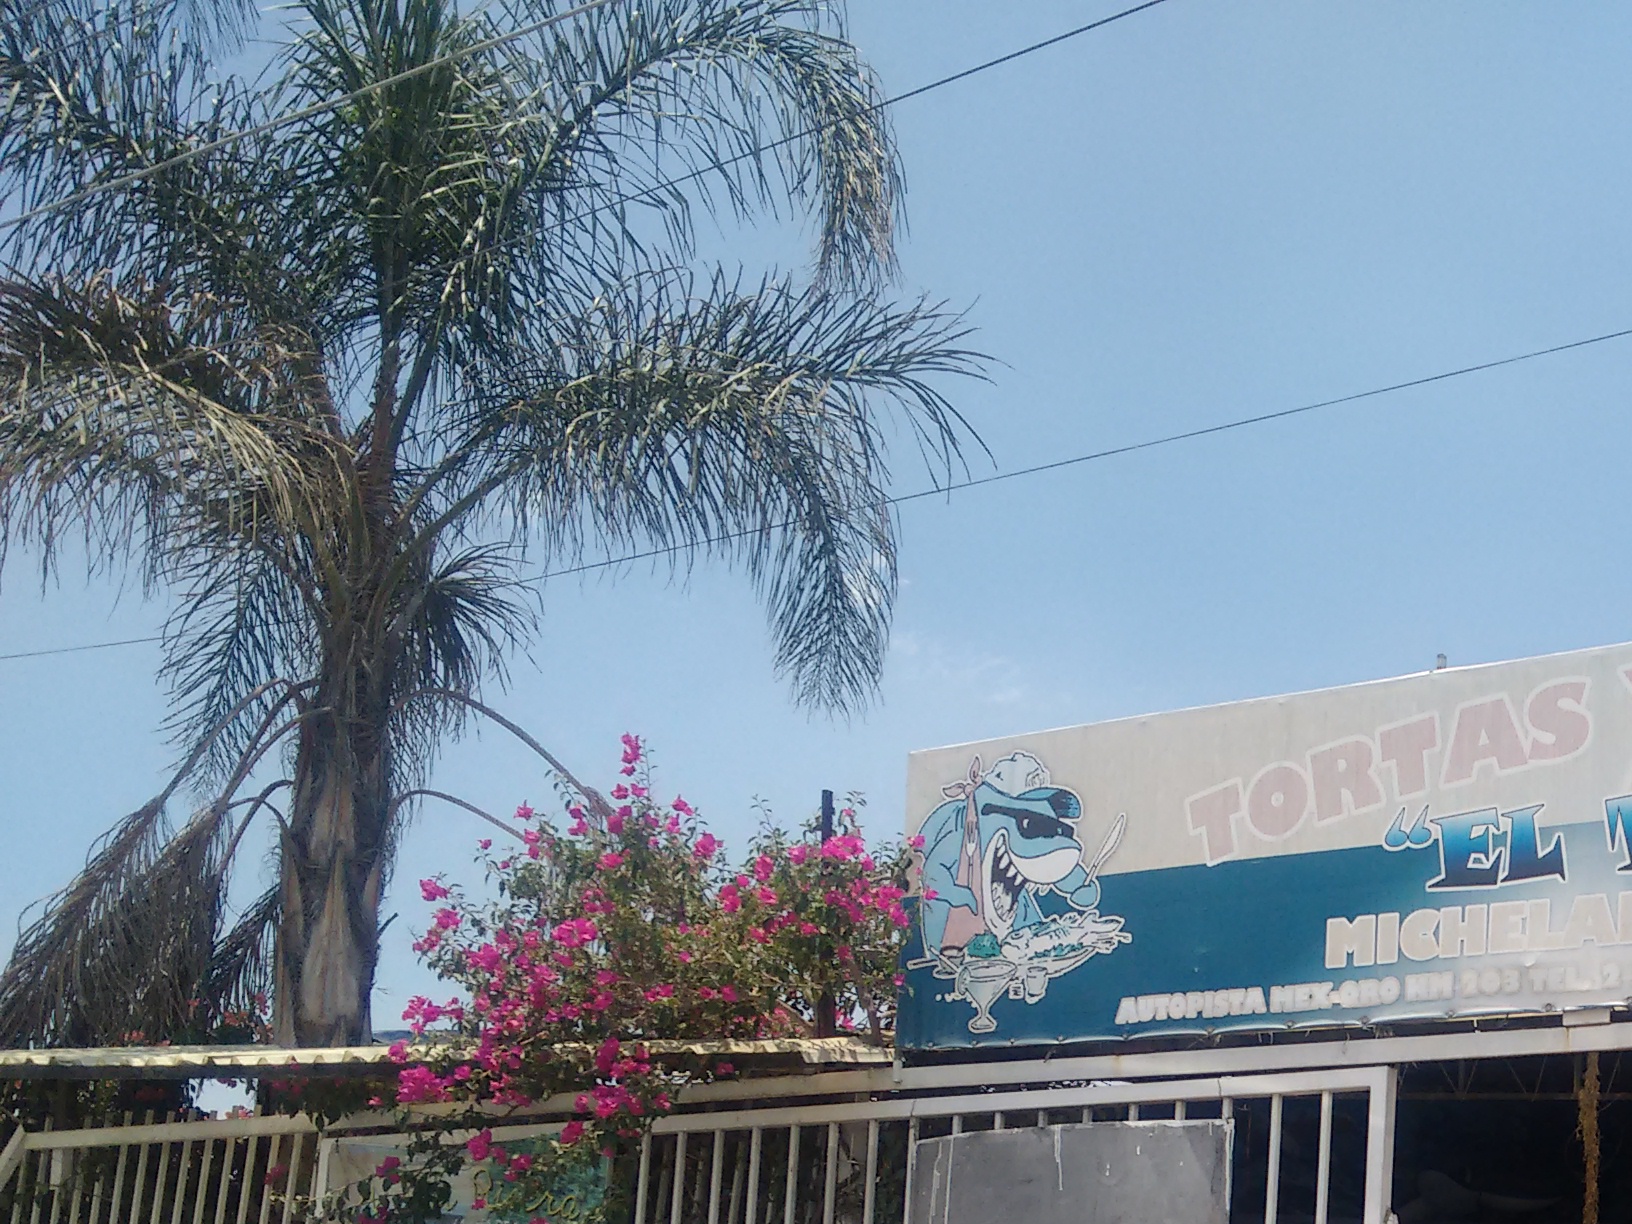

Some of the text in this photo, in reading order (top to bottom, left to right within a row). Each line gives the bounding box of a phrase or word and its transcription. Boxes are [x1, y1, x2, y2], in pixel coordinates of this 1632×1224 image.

[1187, 679, 1591, 866] TORTAS
[1114, 986, 1267, 1025] AUTOPISTA
[1269, 976, 1400, 1013] MEX-QRO
[1460, 967, 1521, 998] 203
